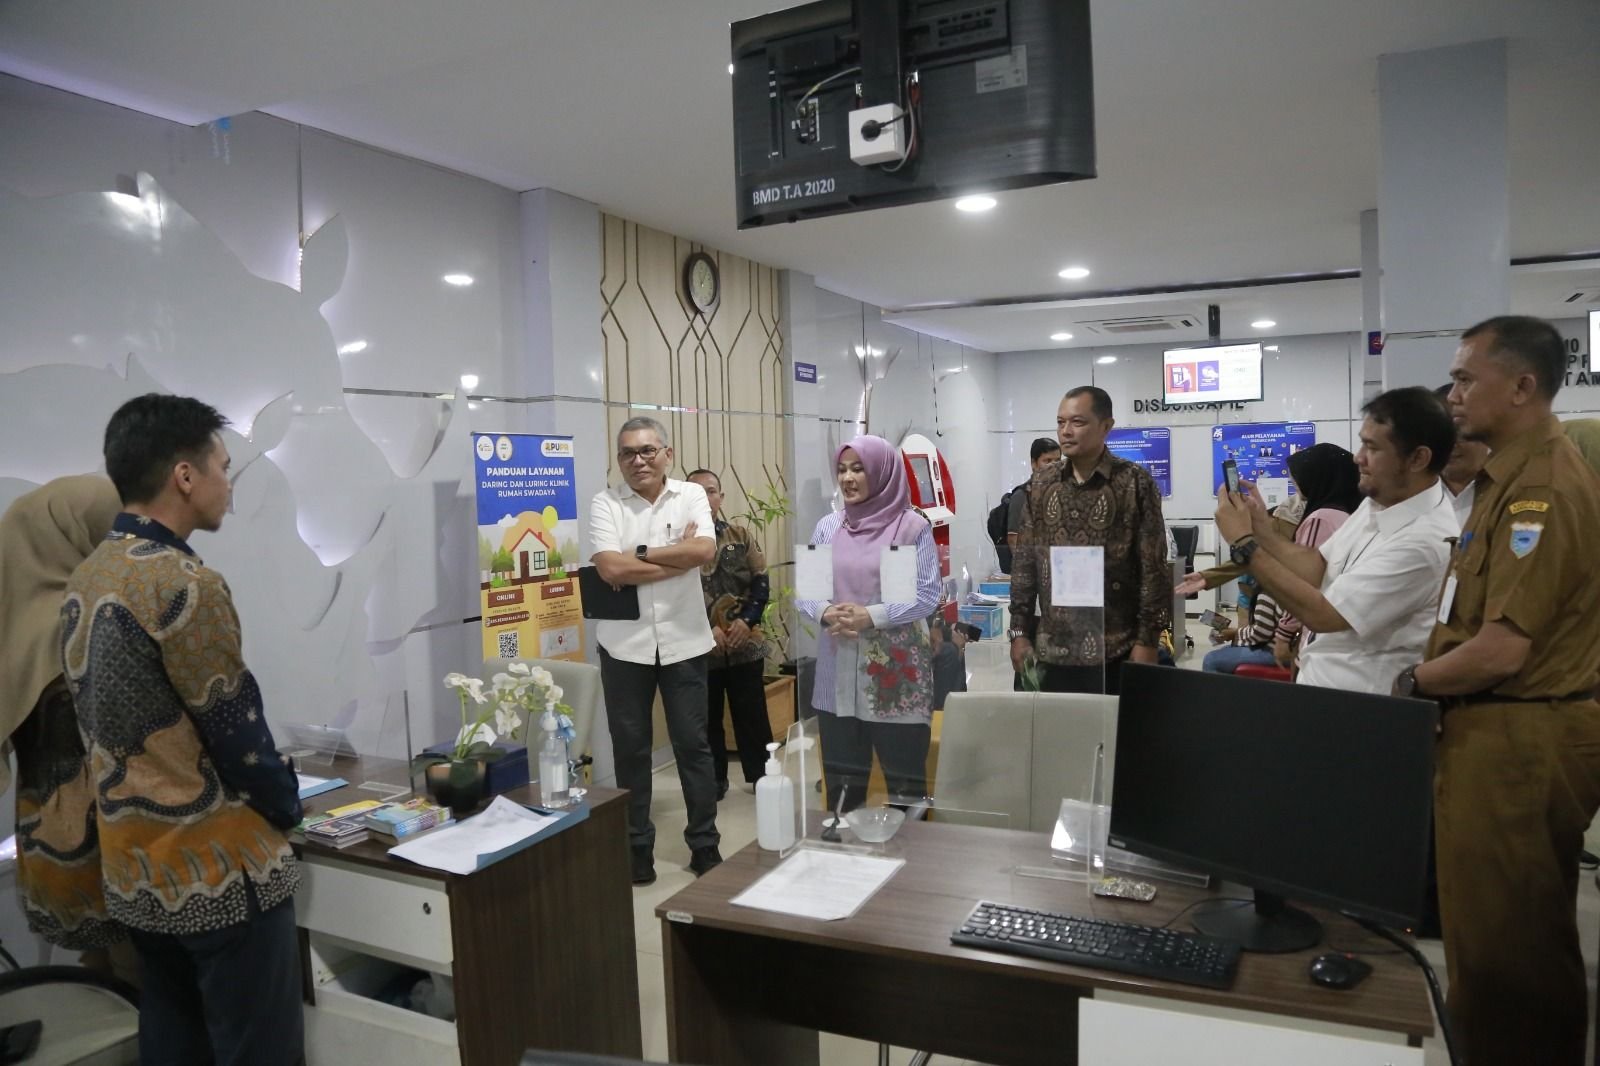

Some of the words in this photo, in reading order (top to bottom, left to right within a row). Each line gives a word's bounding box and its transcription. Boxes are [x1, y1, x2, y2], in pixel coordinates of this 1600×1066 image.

[752, 187, 780, 206] BMD
[782, 183, 802, 200] T.A
[804, 177, 836, 197] 2020
[486, 467, 527, 477] PANDUAN
[528, 467, 565, 476] LAYANAN
[481, 480, 508, 489] DARING
[509, 480, 524, 488] DAN
[524, 480, 549, 488] LURING
[549, 479, 570, 488] KLINIK
[498, 490, 523, 498] RUMAH
[523, 489, 556, 497] SWADAYA
